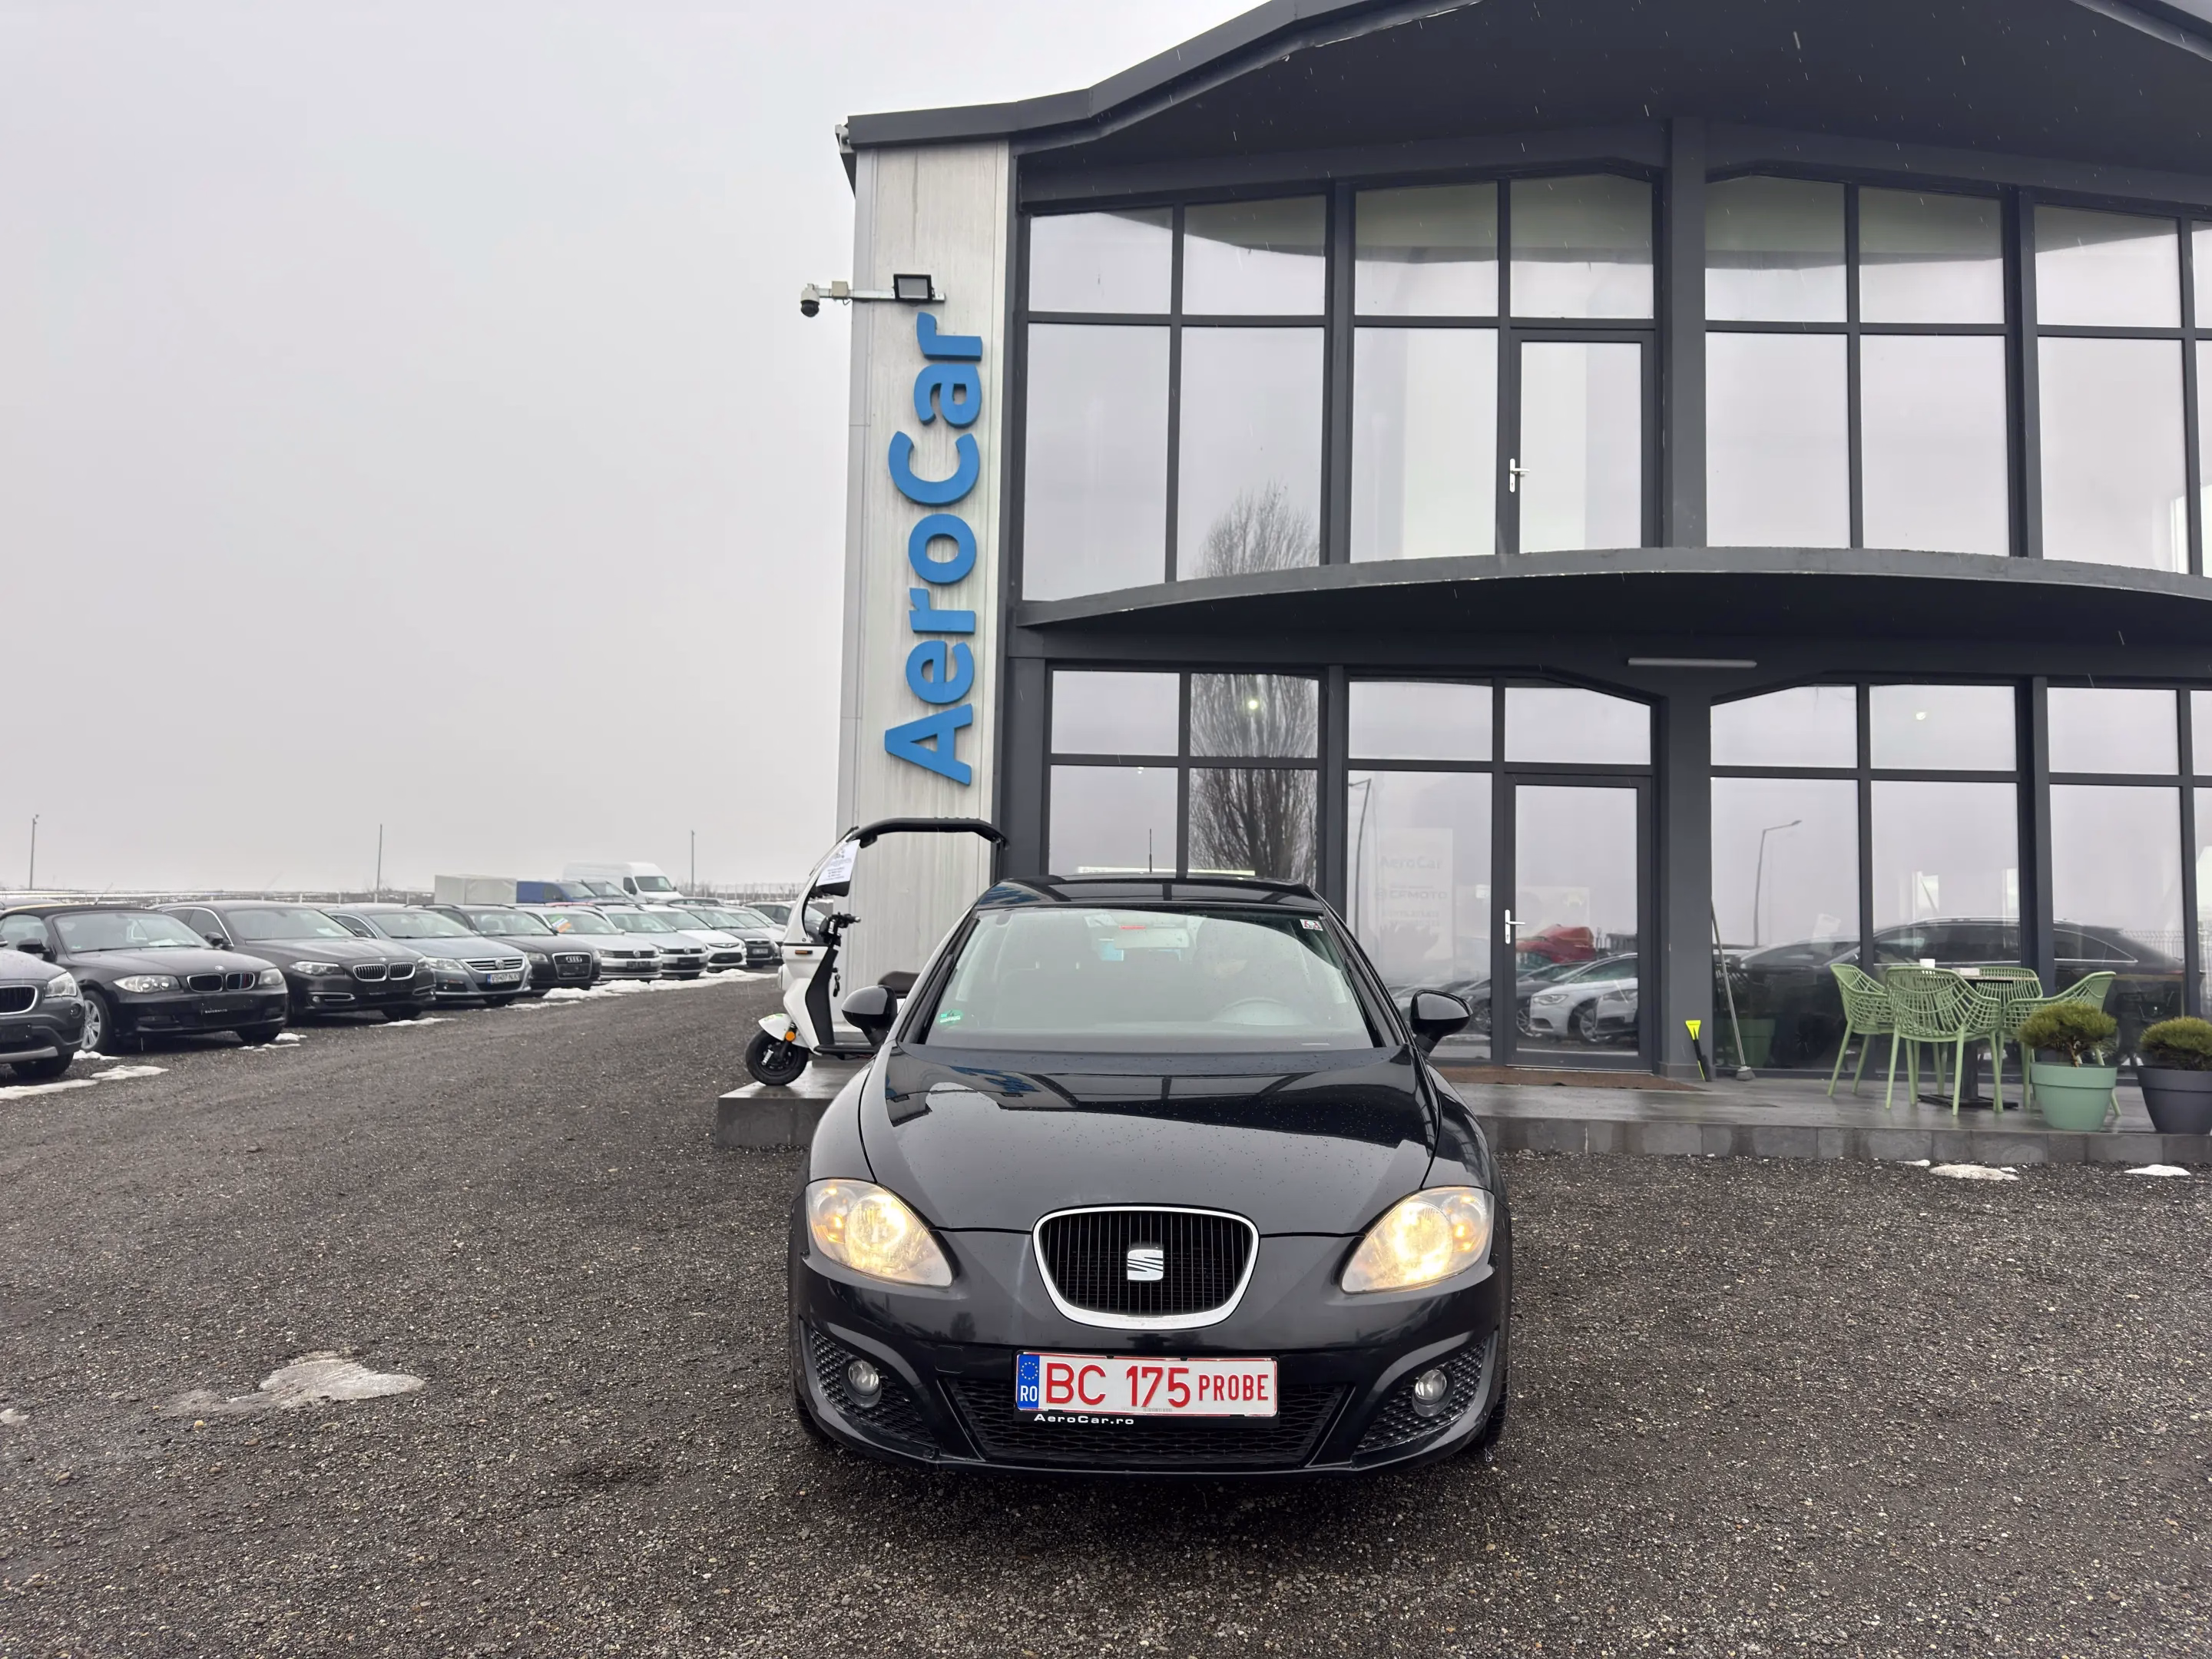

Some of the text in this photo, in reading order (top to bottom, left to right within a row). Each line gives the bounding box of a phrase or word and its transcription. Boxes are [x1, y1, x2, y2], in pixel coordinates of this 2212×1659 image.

[884, 311, 983, 786] AeroCar
[1020, 1385, 1038, 1402] RO
[1045, 1362, 1270, 1409] BC 175 PROBE
[1033, 1413, 1134, 1426] AeroCar.ro
